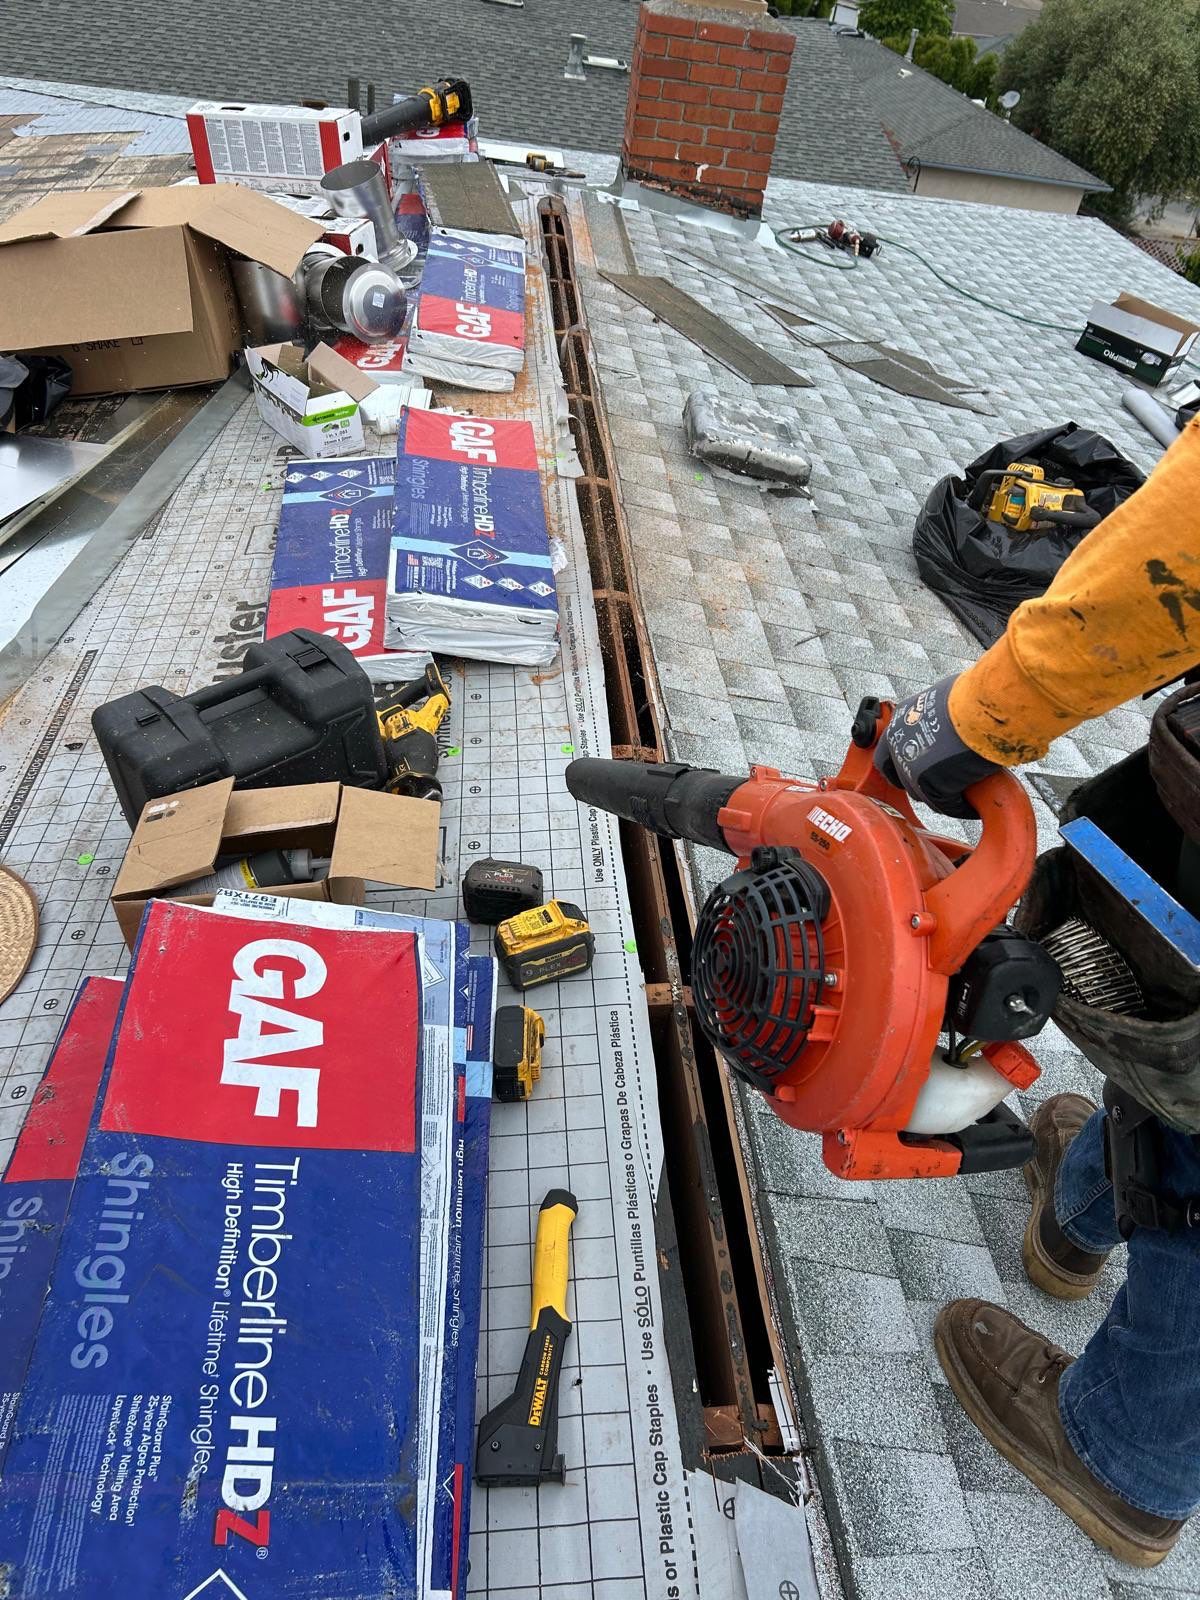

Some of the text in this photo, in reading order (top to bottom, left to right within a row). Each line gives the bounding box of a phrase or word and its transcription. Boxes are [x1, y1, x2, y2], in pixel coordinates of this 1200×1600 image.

[455, 302, 492, 338] GAF
[448, 421, 498, 463] GAF
[406, 458, 430, 500] Shingles
[322, 588, 375, 651] GAF
[15, 783, 30, 804] PARA
[588, 807, 605, 883] Use ONLY Plastic Cap
[812, 806, 853, 842] ECHO
[220, 938, 328, 1127] GAF
[221, 1162, 244, 1200] High
[610, 1010, 654, 1361] Use SÓLO Puntillas Plásticas o Grapas De Cabeza Plástica
[70, 1151, 154, 1370] Shingles
[229, 1157, 301, 1409] Timberline
[543, 1344, 554, 1376] COMPOSITE
[142, 1394, 160, 1433] 25-year
[528, 1377, 549, 1427] DEWALT
[647, 1384, 664, 1445] Staples
[152, 1394, 173, 1453] StainGuard
[189, 1384, 220, 1476] Shingles
[136, 1433, 152, 1467] Algae
[652, 1450, 668, 1486] Cap
[90, 1452, 115, 1515] Technology
[110, 1454, 132, 1492] Nailing
[109, 1494, 122, 1521] Area
[657, 1490, 675, 1554] Plastic
[664, 1559, 678, 1580] or
